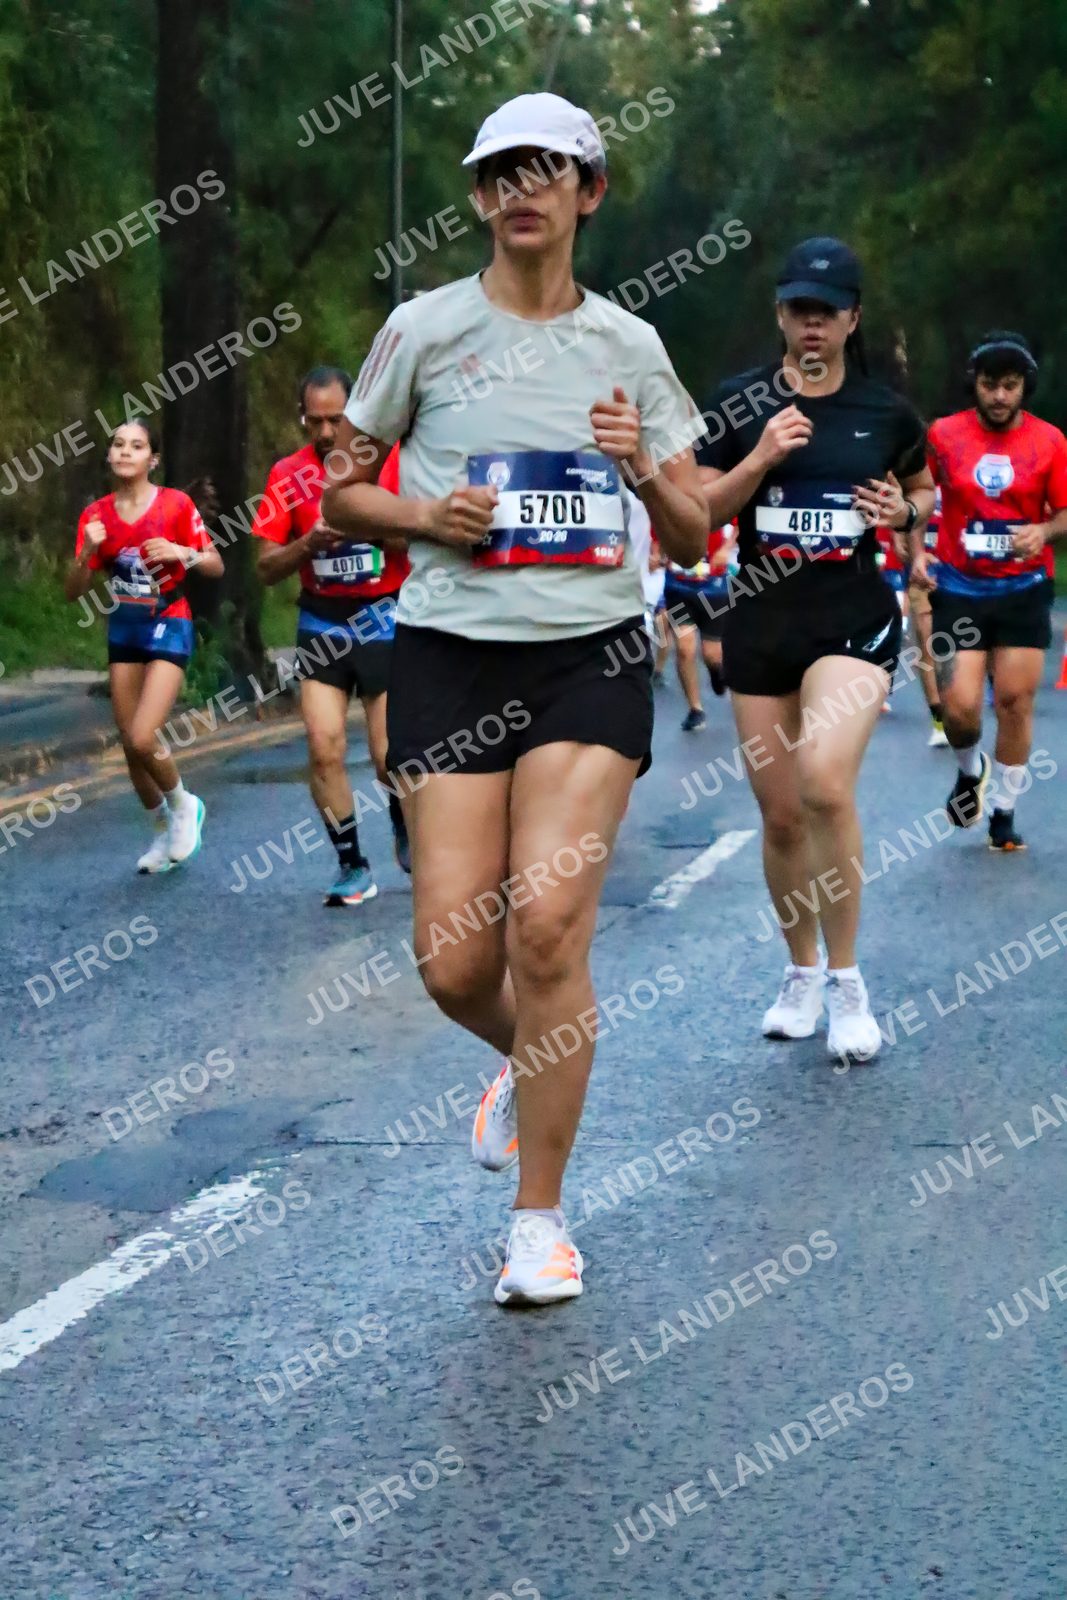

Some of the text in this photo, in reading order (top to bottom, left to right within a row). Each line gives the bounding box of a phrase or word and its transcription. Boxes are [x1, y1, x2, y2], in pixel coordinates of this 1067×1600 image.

[520, 494, 586, 524] 5700
[788, 510, 833, 532] 4813
[332, 556, 364, 573] 4070
